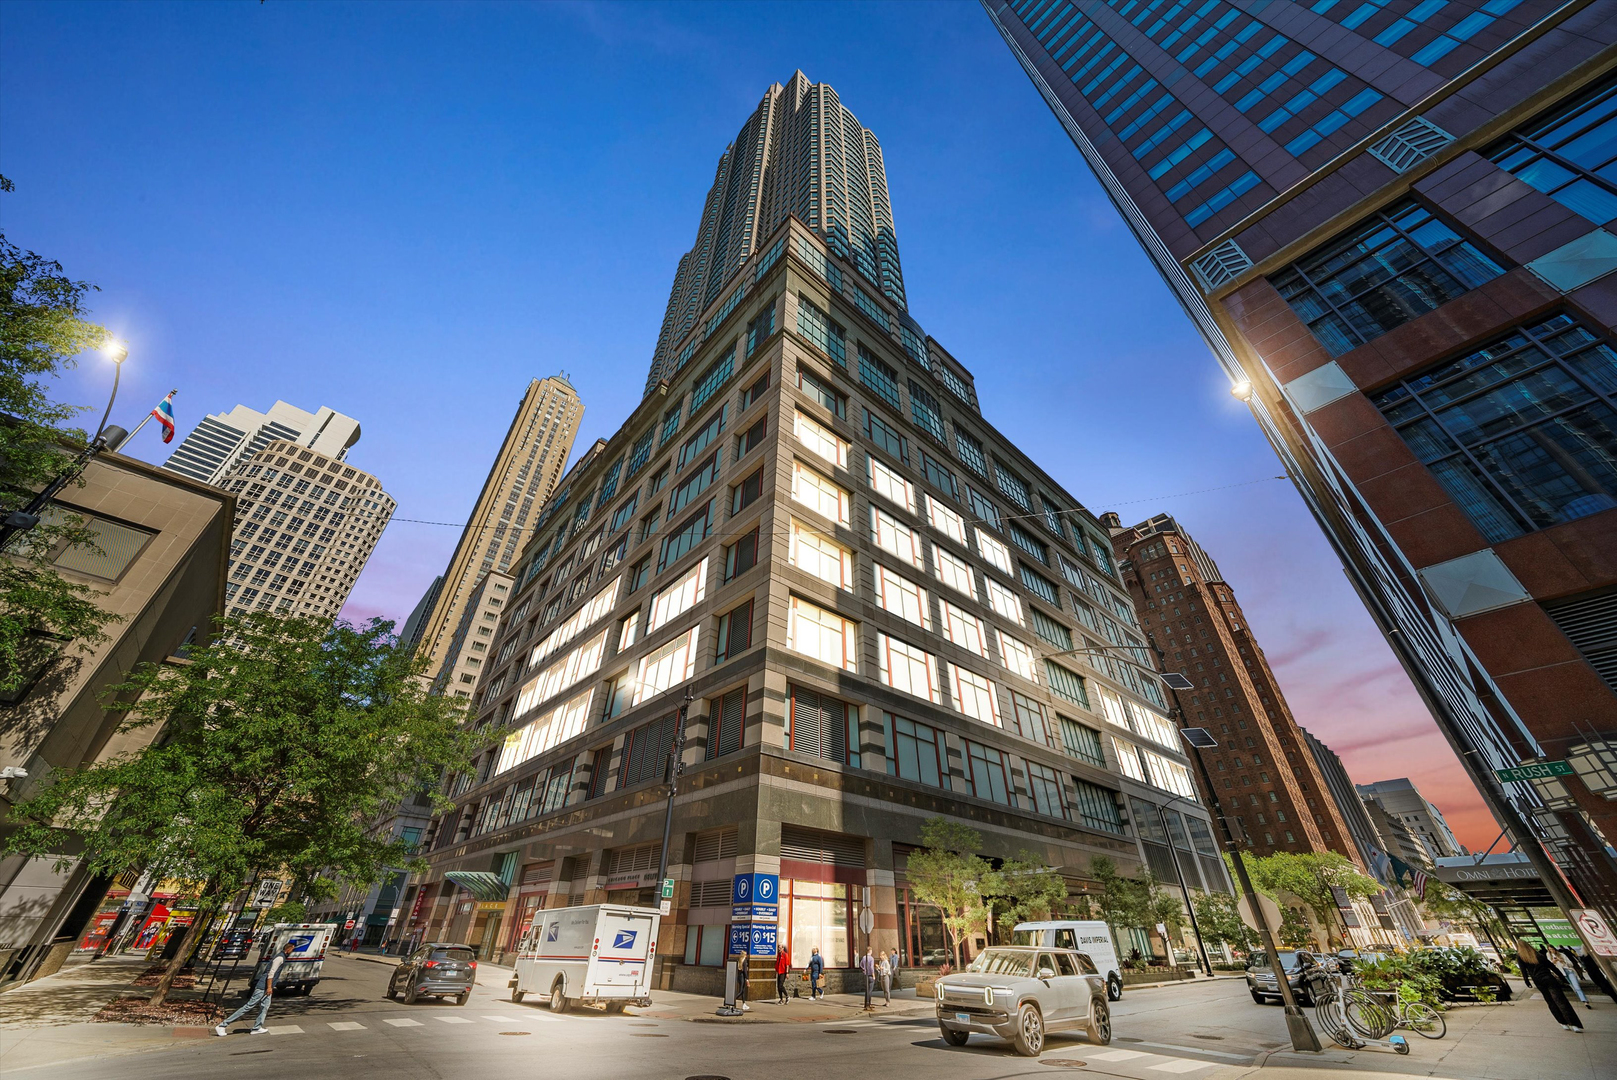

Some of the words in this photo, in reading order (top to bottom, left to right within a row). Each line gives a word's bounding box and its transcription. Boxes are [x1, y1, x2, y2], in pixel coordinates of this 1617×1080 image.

[1511, 765, 1553, 779] RUSH
[1555, 765, 1566, 773] ST
[1456, 870, 1491, 880] OMNI
[1503, 867, 1540, 878] HOTE
[263, 881, 280, 890] ONE
[740, 882, 746, 894] P
[762, 882, 770, 894] P
[259, 889, 278, 897] WAY
[739, 931, 750, 943] $15
[762, 931, 775, 943] $15
[1080, 936, 1092, 944] DAVIS
[1092, 936, 1109, 944] IMPERIAL
